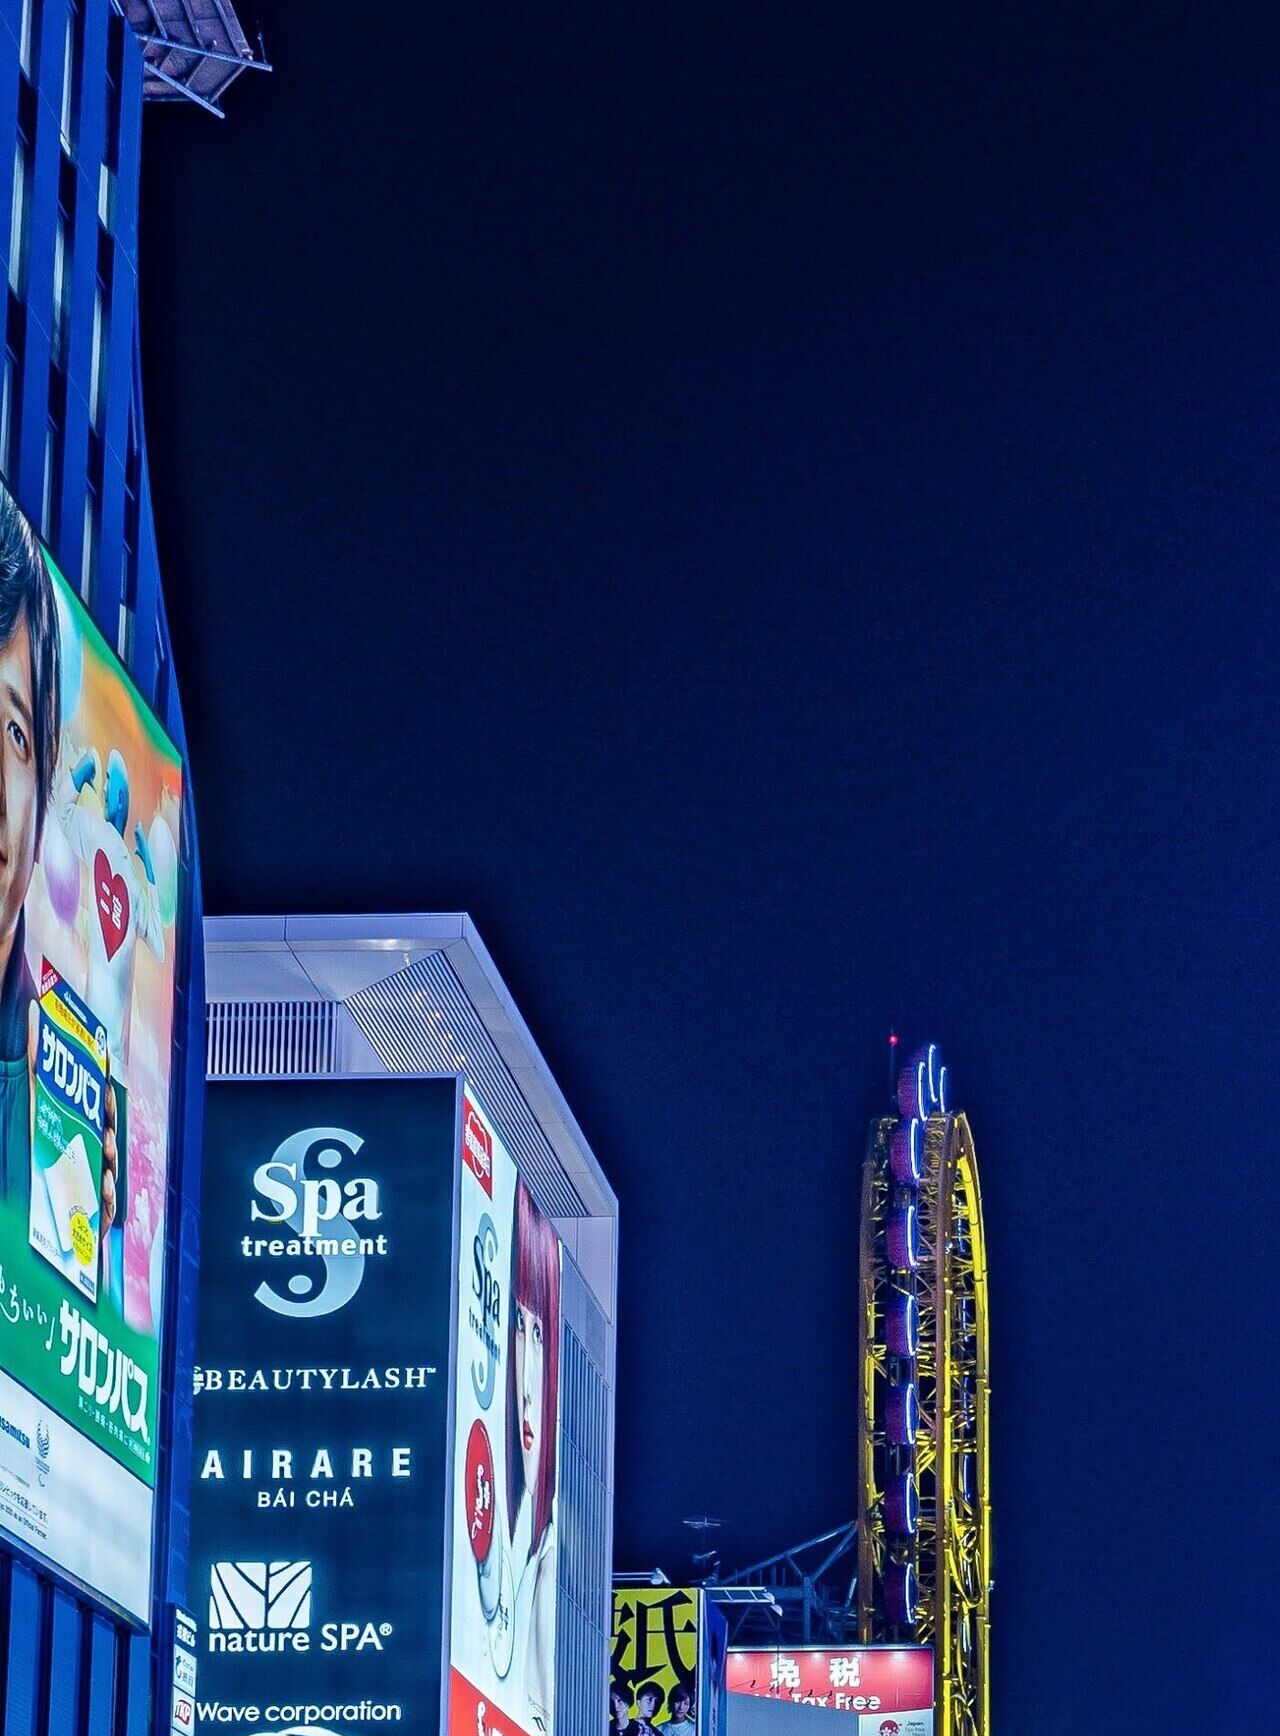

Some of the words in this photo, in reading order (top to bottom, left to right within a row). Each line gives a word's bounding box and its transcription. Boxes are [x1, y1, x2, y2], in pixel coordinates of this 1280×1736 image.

[42, 1024, 103, 1130] サロンパス
[250, 1161, 382, 1237] Spa
[241, 1234, 388, 1258] treatment
[60, 1299, 151, 1446] サロンパス
[200, 1447, 412, 1480] AIRARE
[257, 1487, 295, 1508] BÁI
[305, 1486, 354, 1508] CHÁ
[208, 1629, 311, 1653] nature
[769, 1656, 861, 1688] 免税
[197, 1702, 259, 1722] Wave
[265, 1701, 401, 1724] corporation
[835, 1693, 882, 1712] Free
